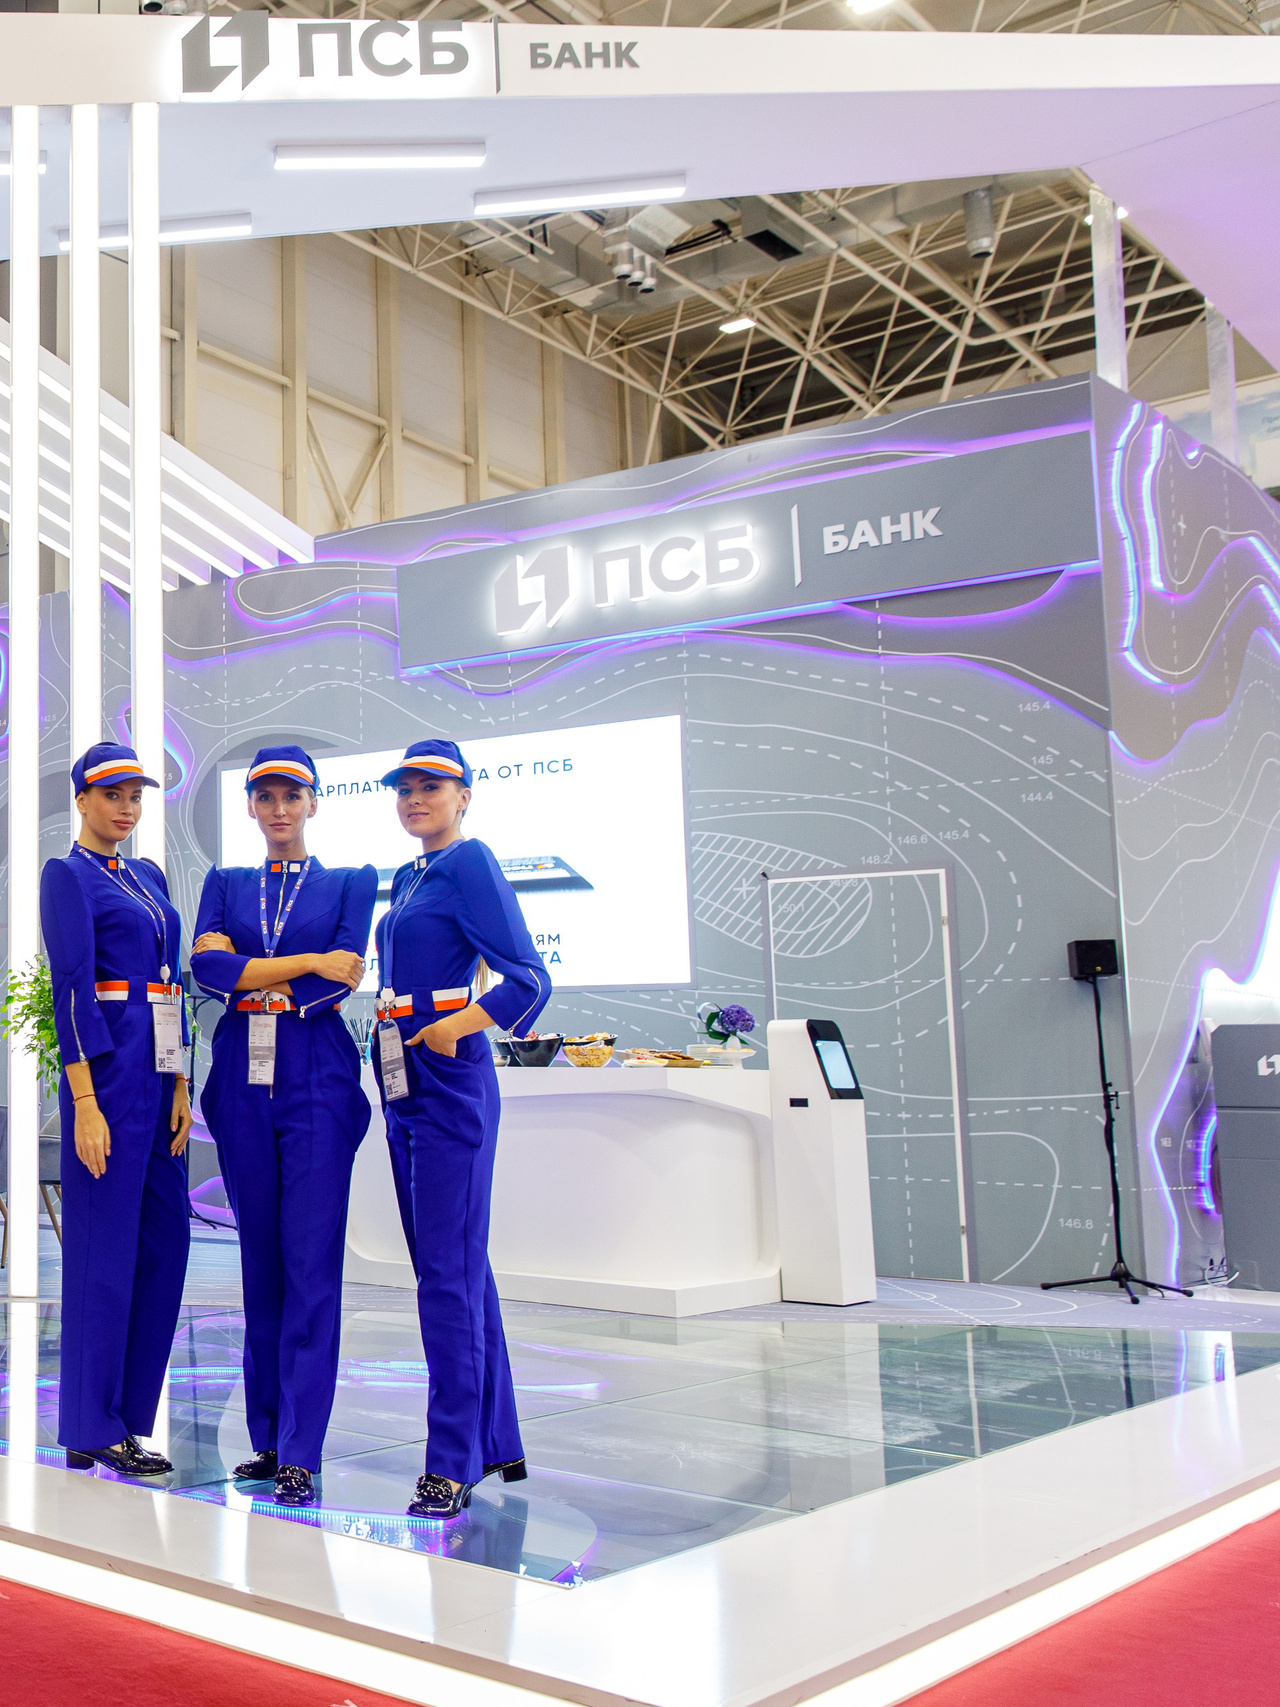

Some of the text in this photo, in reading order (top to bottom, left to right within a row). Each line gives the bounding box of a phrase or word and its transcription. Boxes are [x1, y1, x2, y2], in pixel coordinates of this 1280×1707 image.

[297, 20, 639, 77] ПСБ БАНК
[593, 506, 944, 608] ПСБ БАНК
[1018, 701, 1051, 712] 145.4
[1031, 755, 1053, 766] 145
[498, 763, 523, 779] ОТ
[533, 758, 573, 775] ПСБ
[1020, 791, 1053, 803] 144.4
[897, 835, 928, 845] 146.6
[937, 830, 969, 840] 145.4
[860, 855, 891, 865] 148.2
[1058, 1218, 1094, 1230] 146.8
